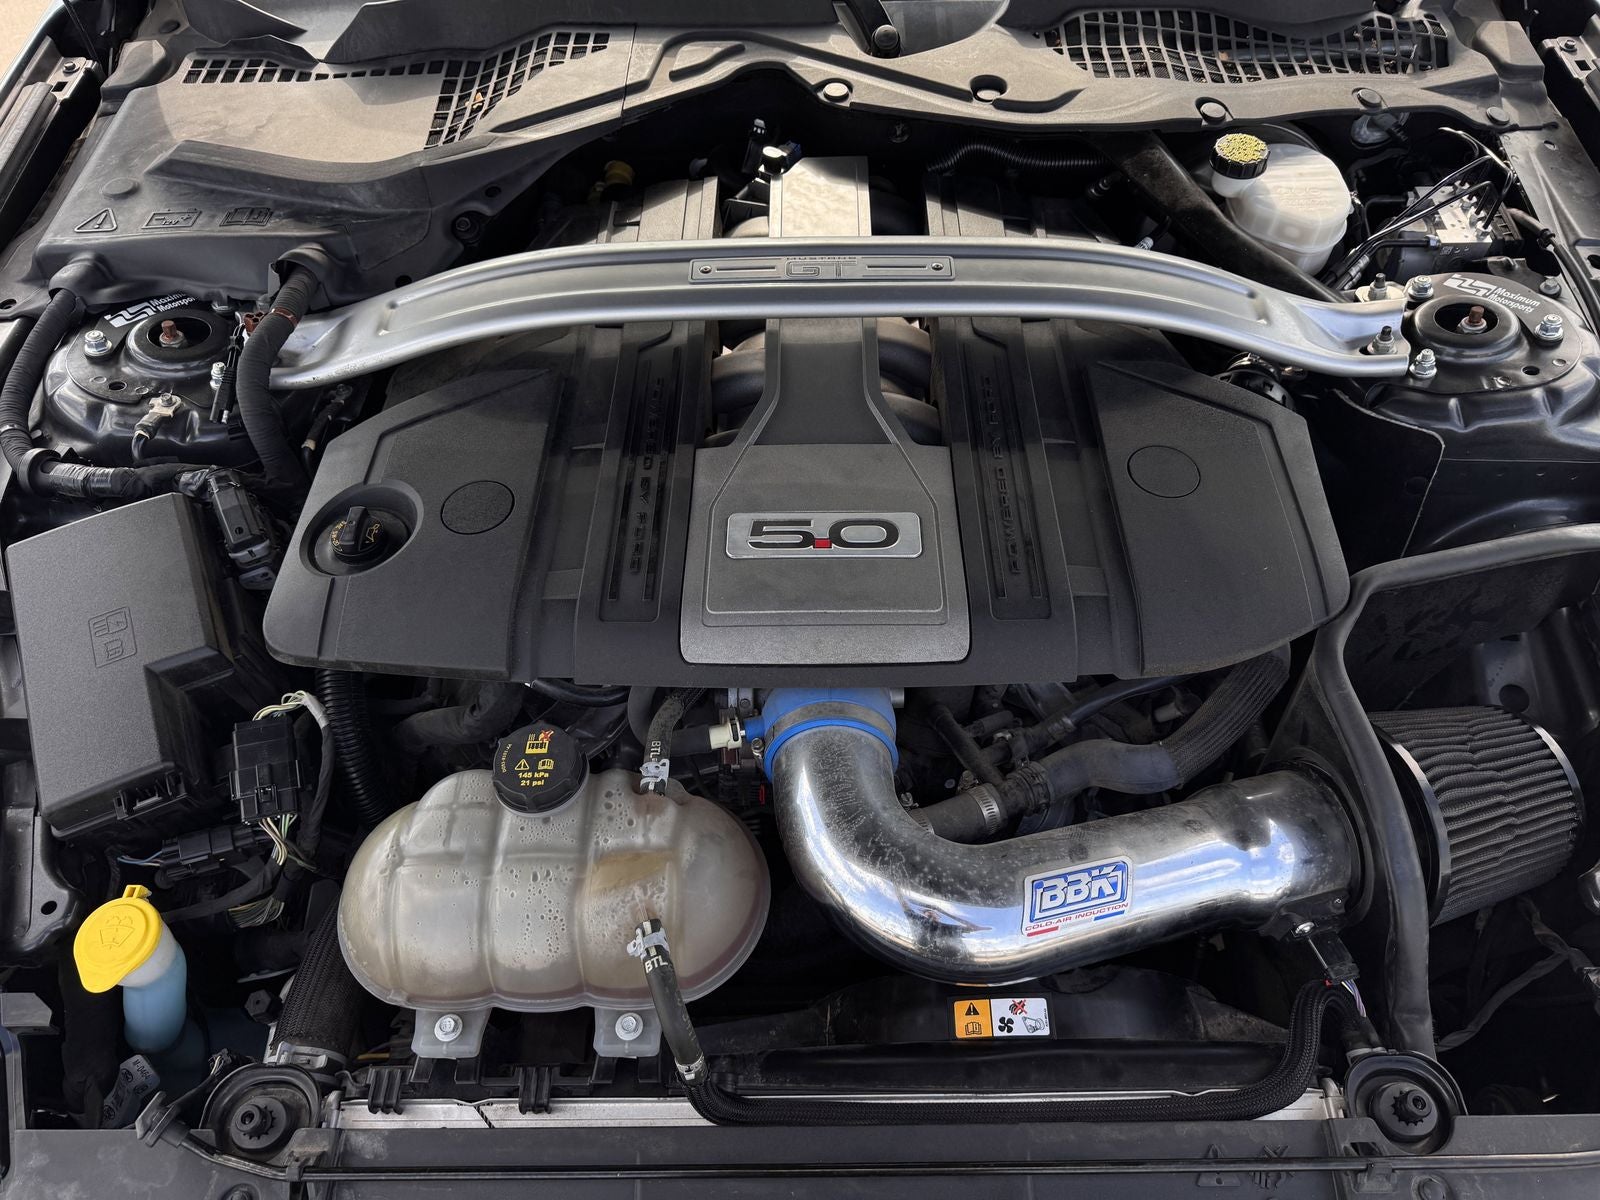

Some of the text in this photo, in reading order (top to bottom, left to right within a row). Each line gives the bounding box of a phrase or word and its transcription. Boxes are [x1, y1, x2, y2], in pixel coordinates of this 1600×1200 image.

[785, 260, 857, 278] GT
[149, 293, 186, 307] Maxim
[1487, 293, 1535, 314] Motorsports
[1493, 287, 1541, 307] Maximum
[994, 467, 1022, 575] POWERED
[748, 518, 900, 550] 5.0
[649, 740, 661, 759] BTL
[532, 779, 545, 787] psi
[1040, 865, 1118, 911] BBK
[1075, 902, 1129, 919] INDUCTION
[644, 954, 669, 974] BTL
